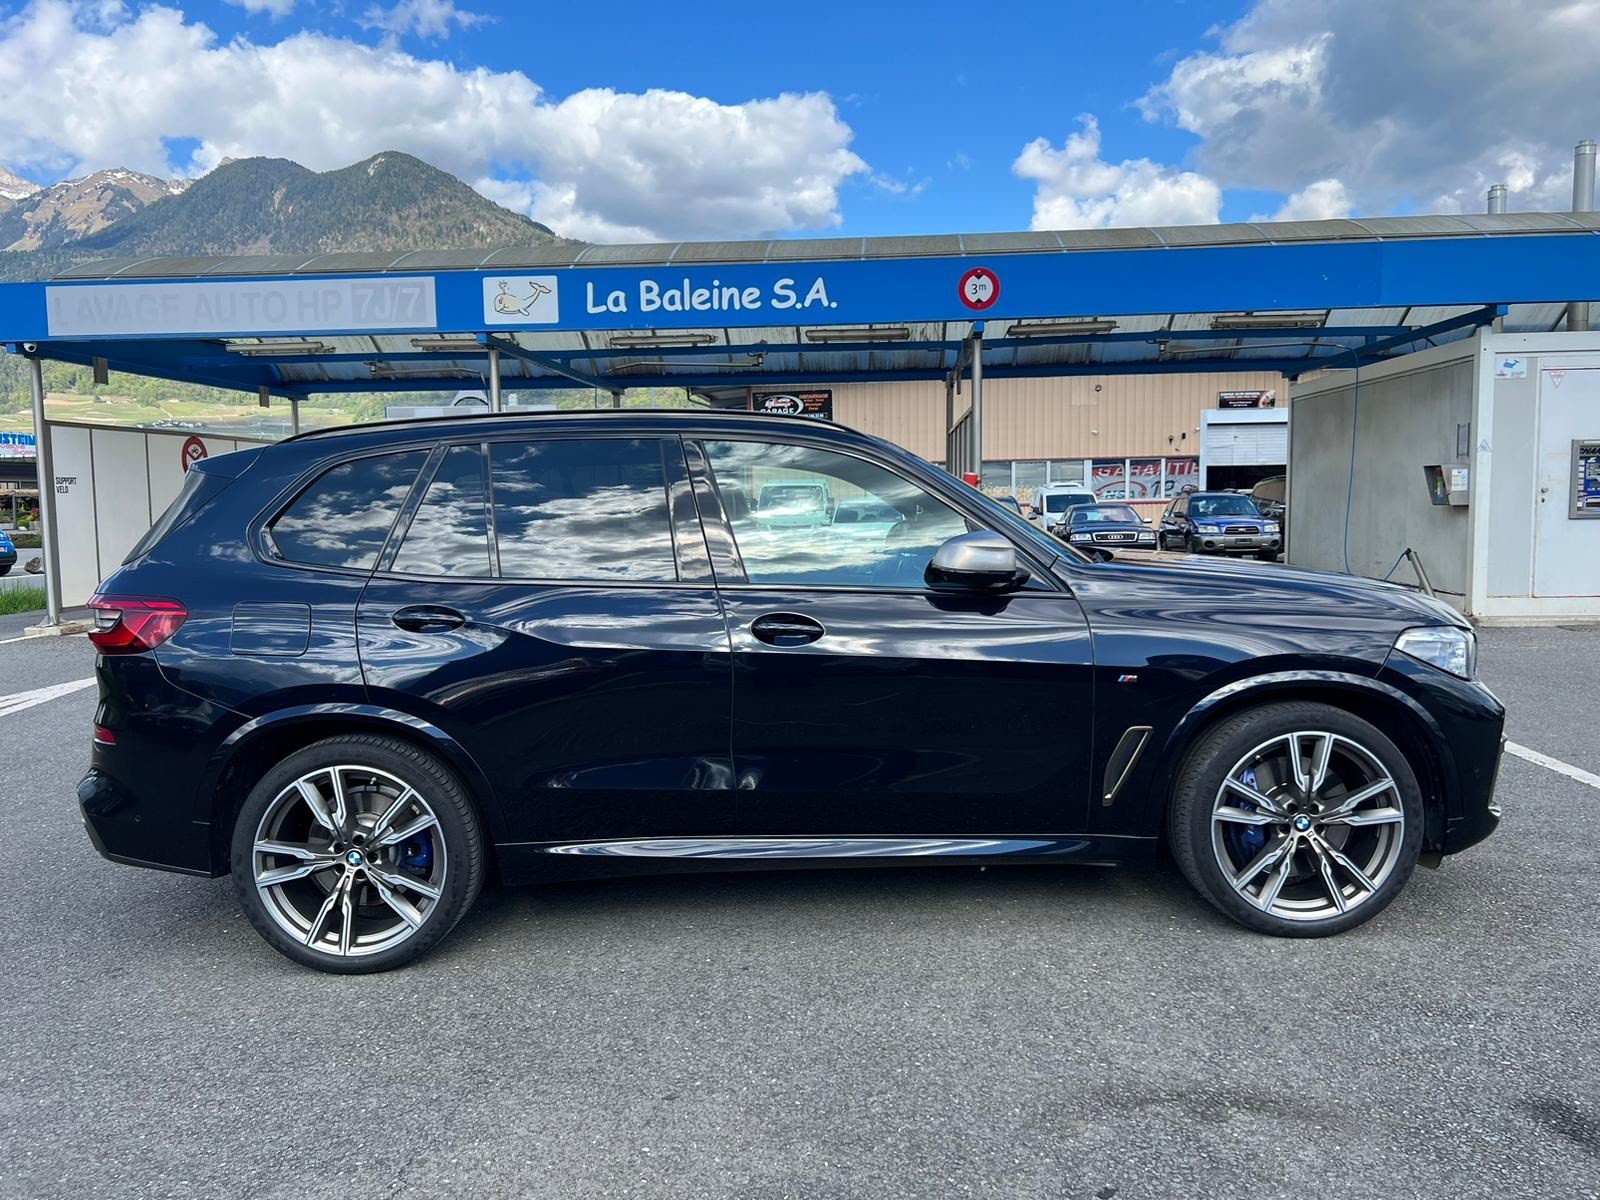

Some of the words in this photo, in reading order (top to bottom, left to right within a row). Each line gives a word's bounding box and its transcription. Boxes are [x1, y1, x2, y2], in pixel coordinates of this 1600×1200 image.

[53, 294, 181, 326] LAVAGE
[193, 289, 288, 325] AUTO
[297, 289, 343, 323] HP
[354, 285, 422, 322] 7J/7
[586, 281, 628, 314] La
[639, 278, 762, 312] Baleine
[770, 276, 838, 309] S.A.
[55, 476, 77, 485] SUPPORT
[55, 485, 69, 494] VELO
